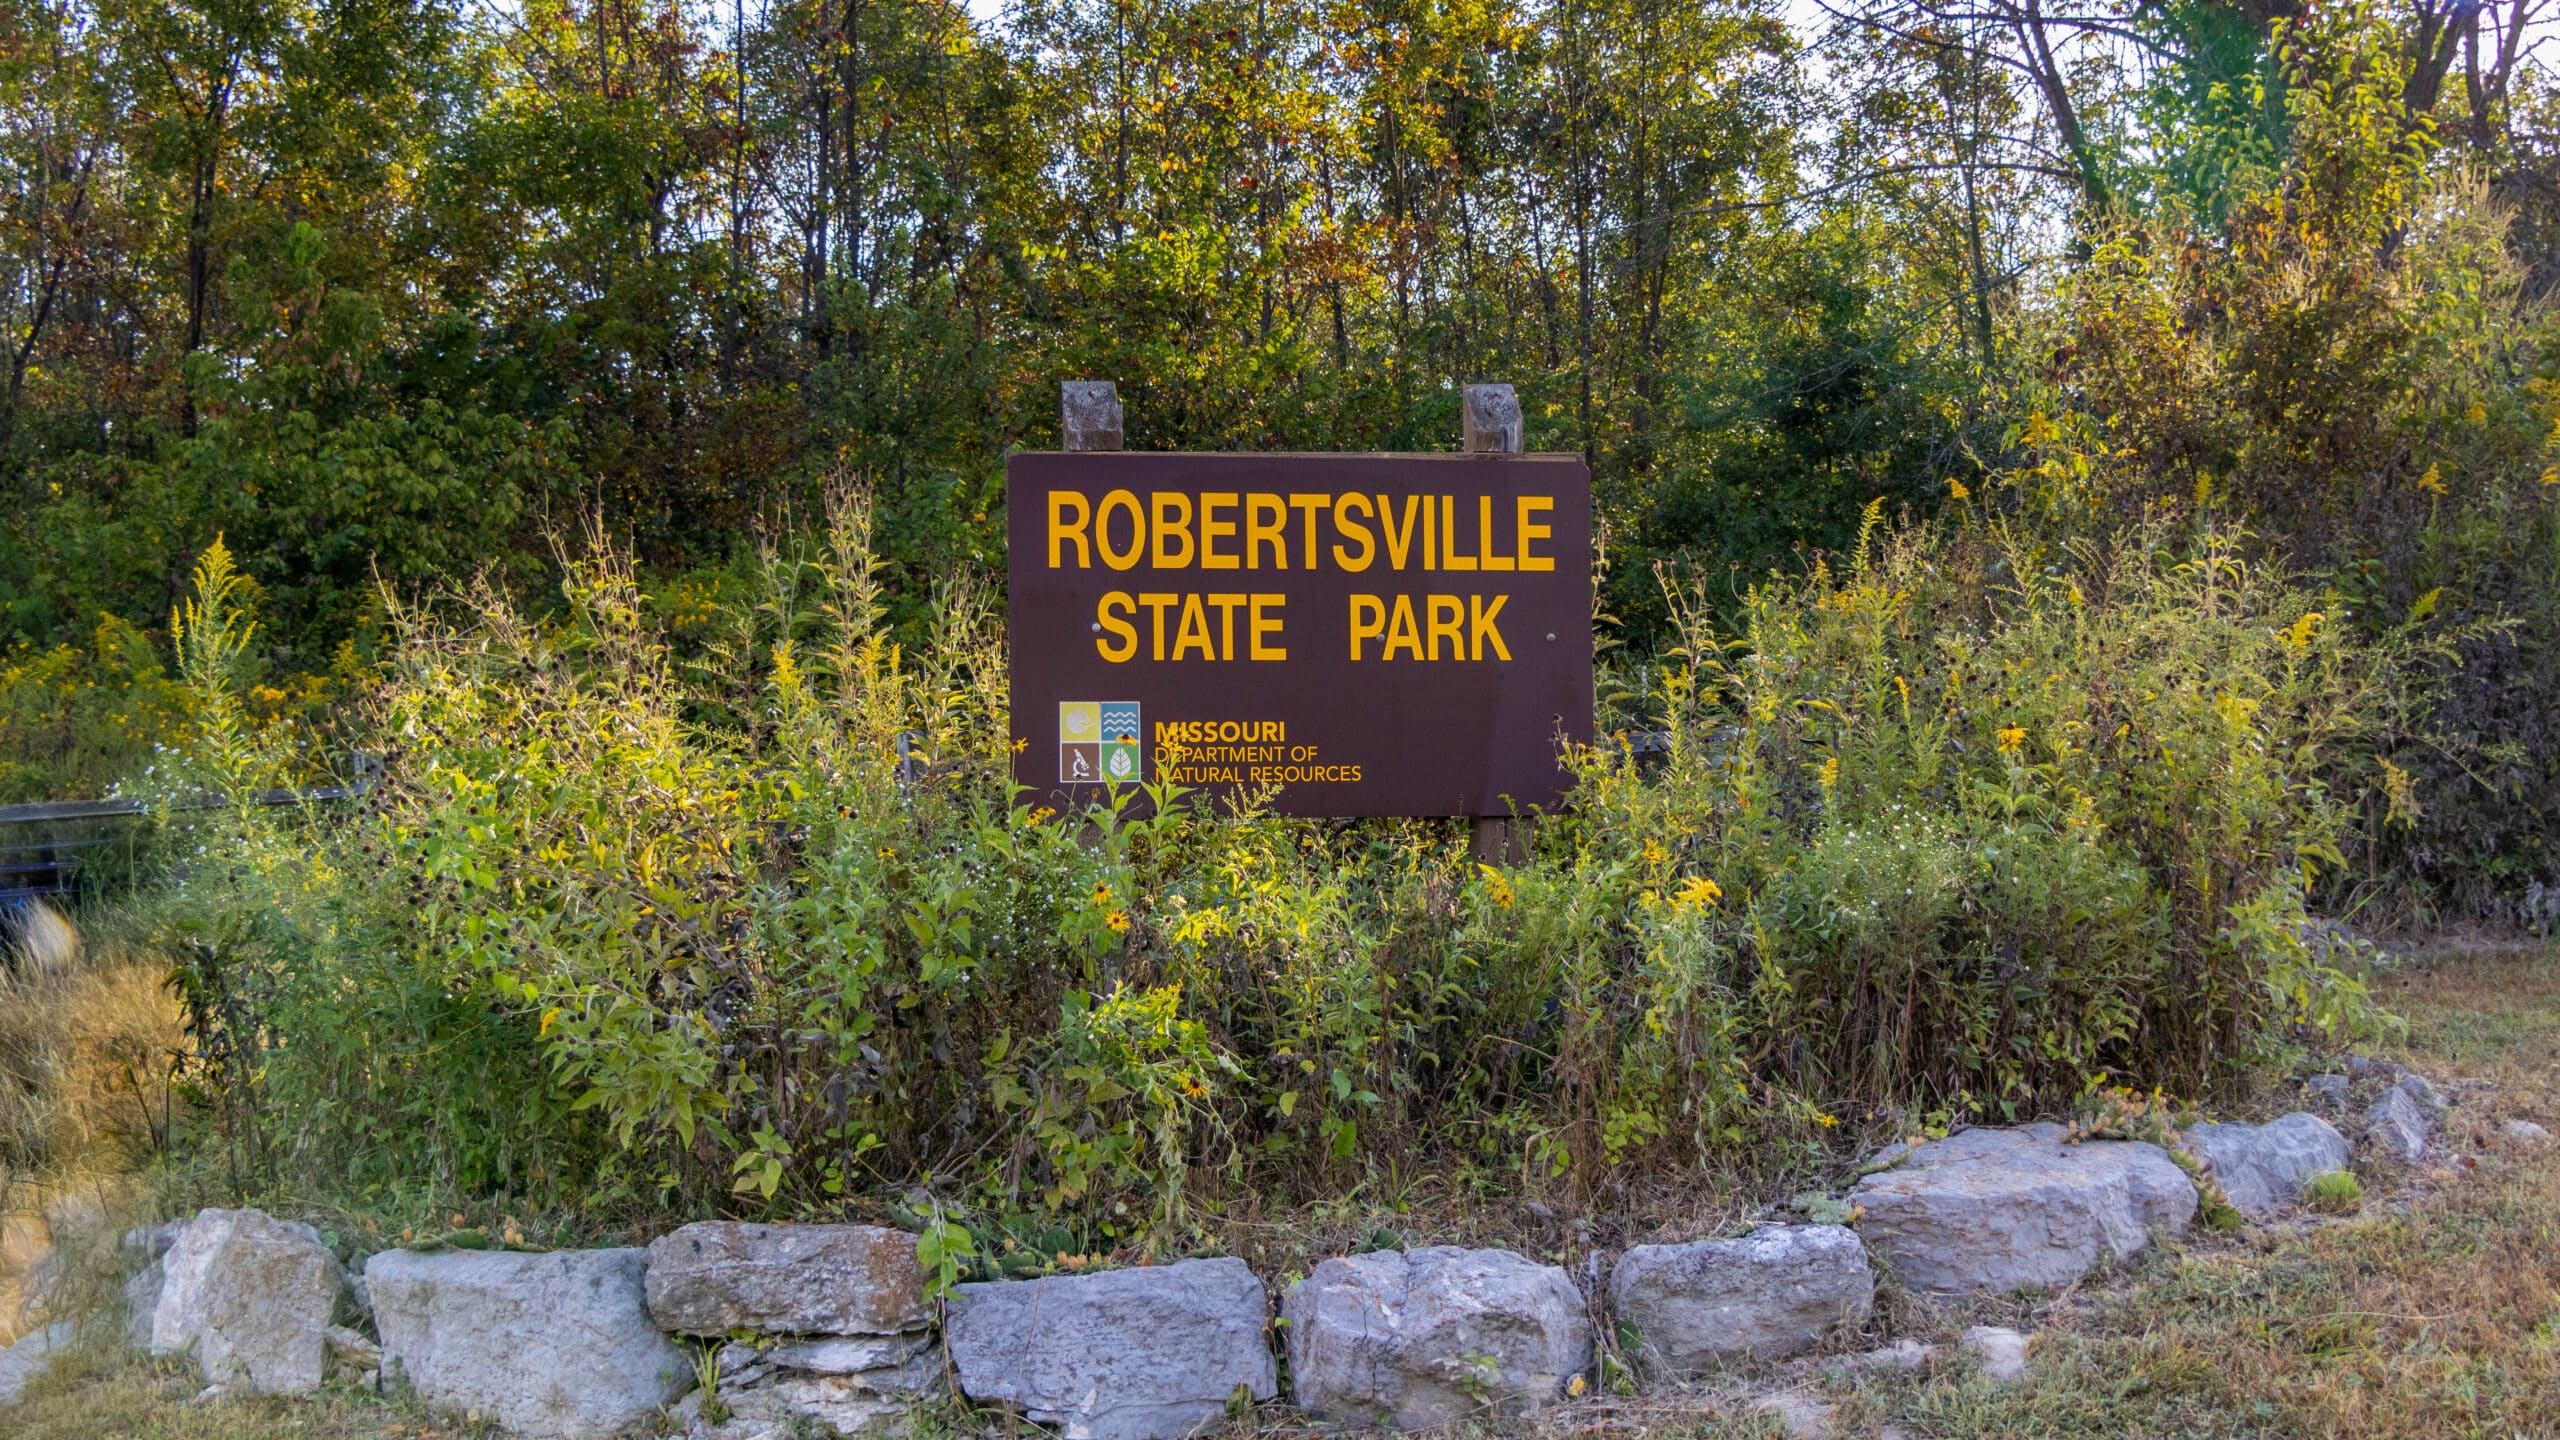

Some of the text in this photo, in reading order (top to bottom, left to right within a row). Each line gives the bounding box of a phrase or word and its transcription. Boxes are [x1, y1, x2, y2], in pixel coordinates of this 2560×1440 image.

[1047, 488, 1556, 573] ROBERTSVILLE
[1095, 590, 1513, 664] STATE PARK
[1155, 720, 1285, 743] MISSOURI
[1155, 745, 1318, 763] DPARTMENT OF
[1250, 765, 1362, 783] RESOURCES
